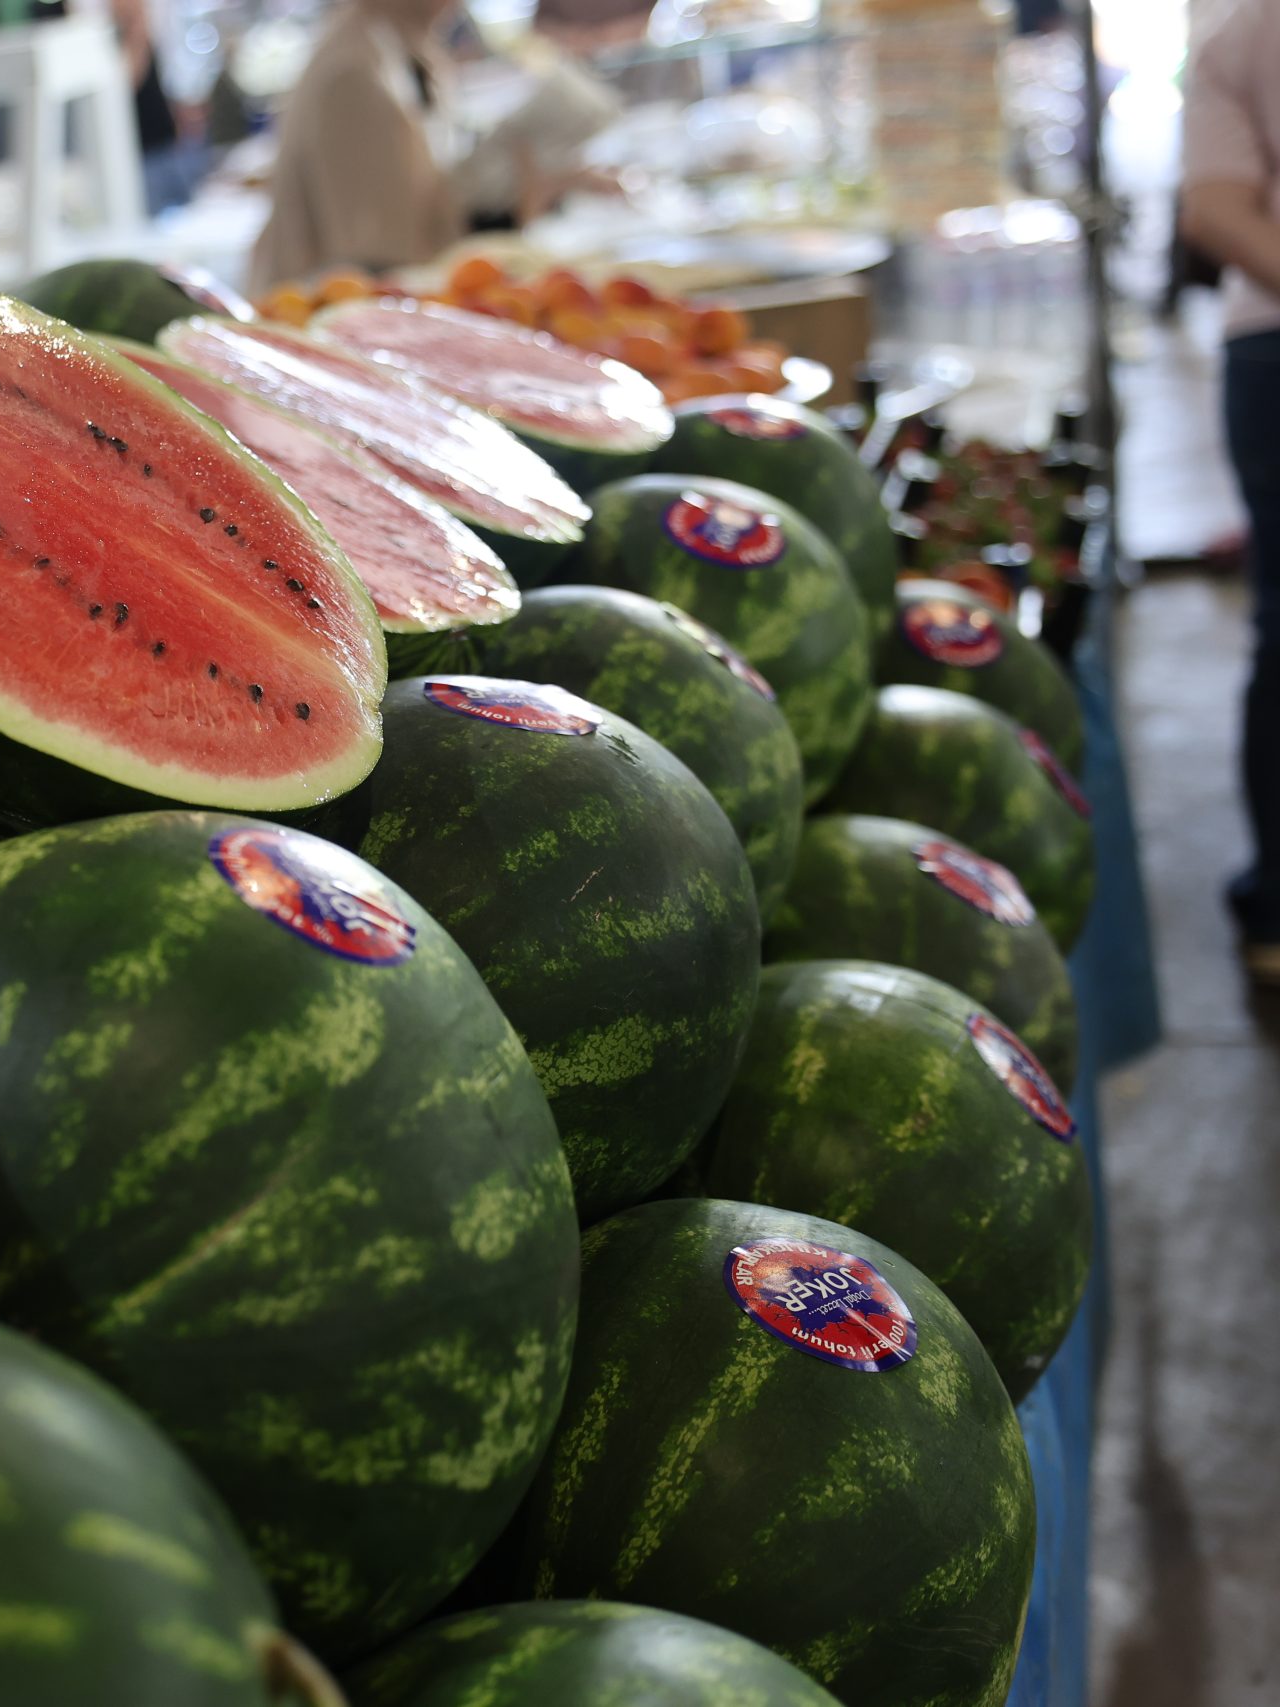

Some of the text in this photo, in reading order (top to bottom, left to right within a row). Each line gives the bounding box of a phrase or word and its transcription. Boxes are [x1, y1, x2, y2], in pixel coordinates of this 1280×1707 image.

[457, 702, 511, 723] tohum
[773, 1266, 863, 1313] JOKER
[791, 1326, 857, 1358] tohum
[888, 1318, 905, 1345] 100
